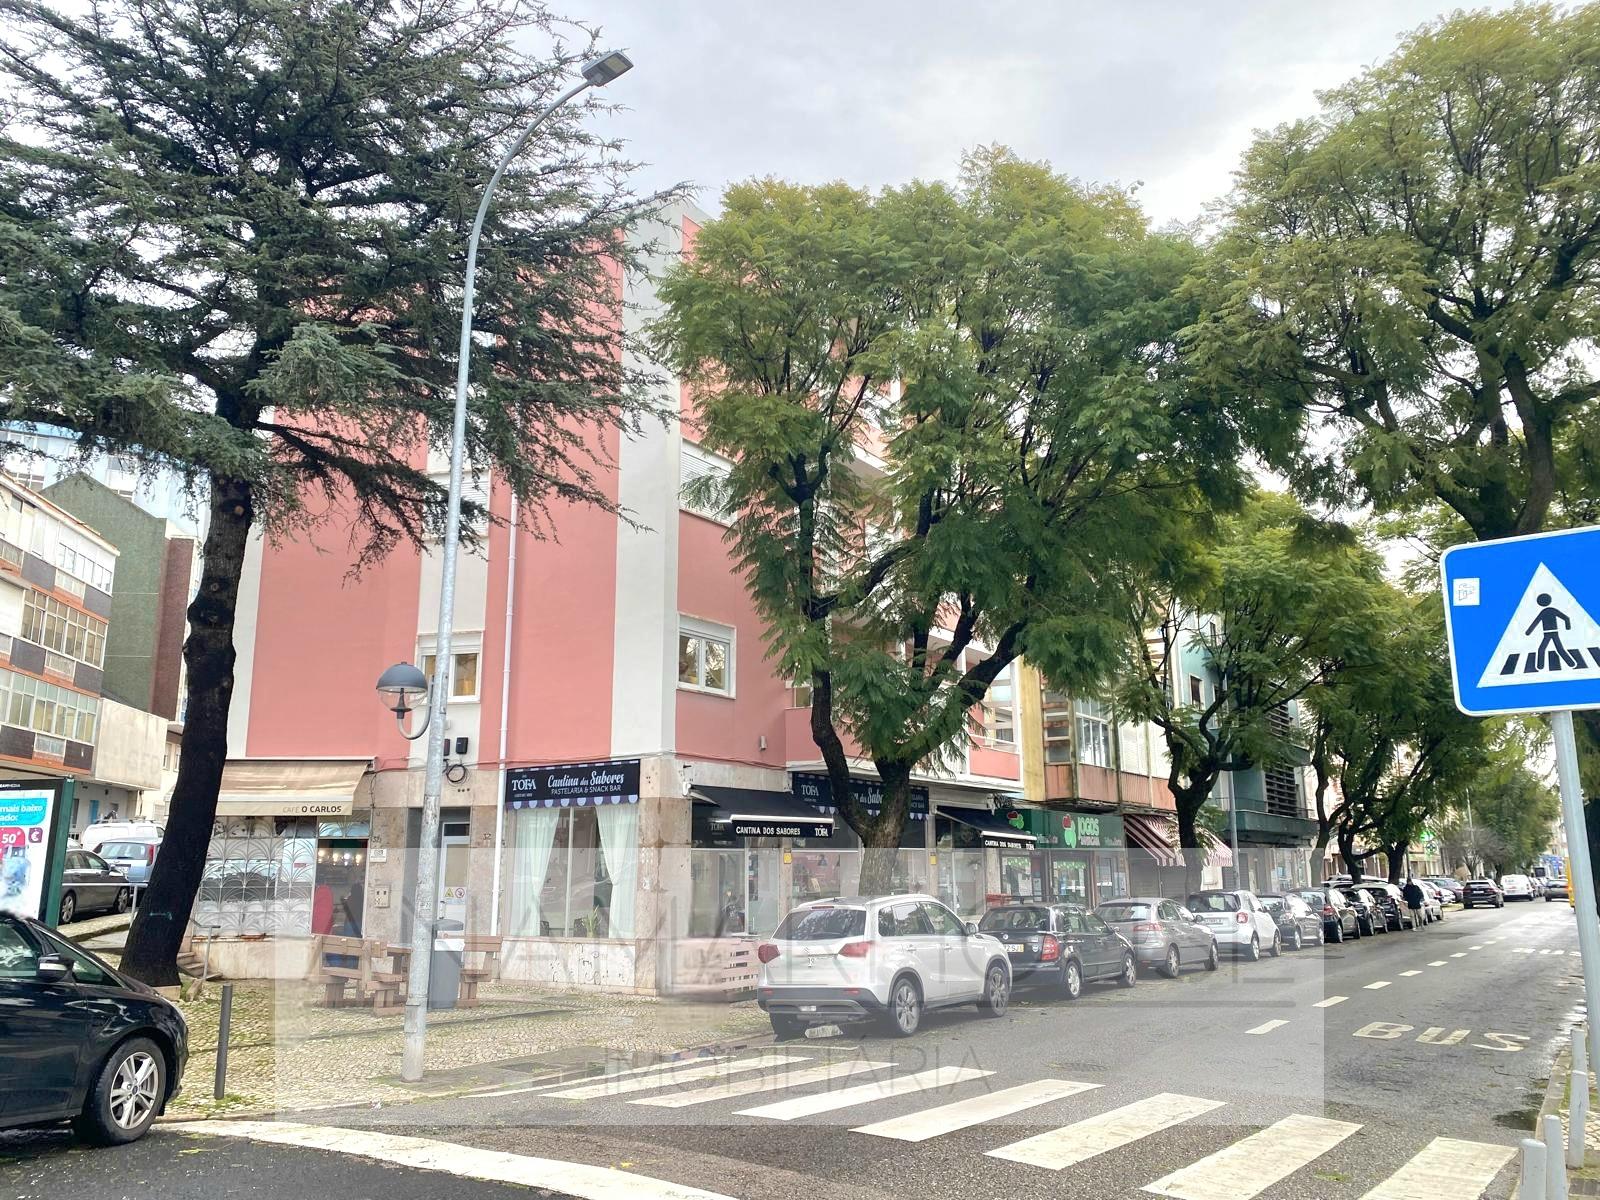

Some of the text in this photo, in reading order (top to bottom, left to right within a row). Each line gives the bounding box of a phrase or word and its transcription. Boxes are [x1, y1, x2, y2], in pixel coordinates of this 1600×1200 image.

[547, 770, 625, 788] Cantina dos Sabores
[551, 784, 622, 795] PASTELARIA & SNACK BAR
[301, 805, 308, 813] O
[309, 805, 342, 813] CARLOS
[735, 826, 761, 835] CANTINA
[762, 826, 775, 835] DOS
[775, 827, 801, 836] SABORES
[1351, 1020, 1532, 1053] BUS
